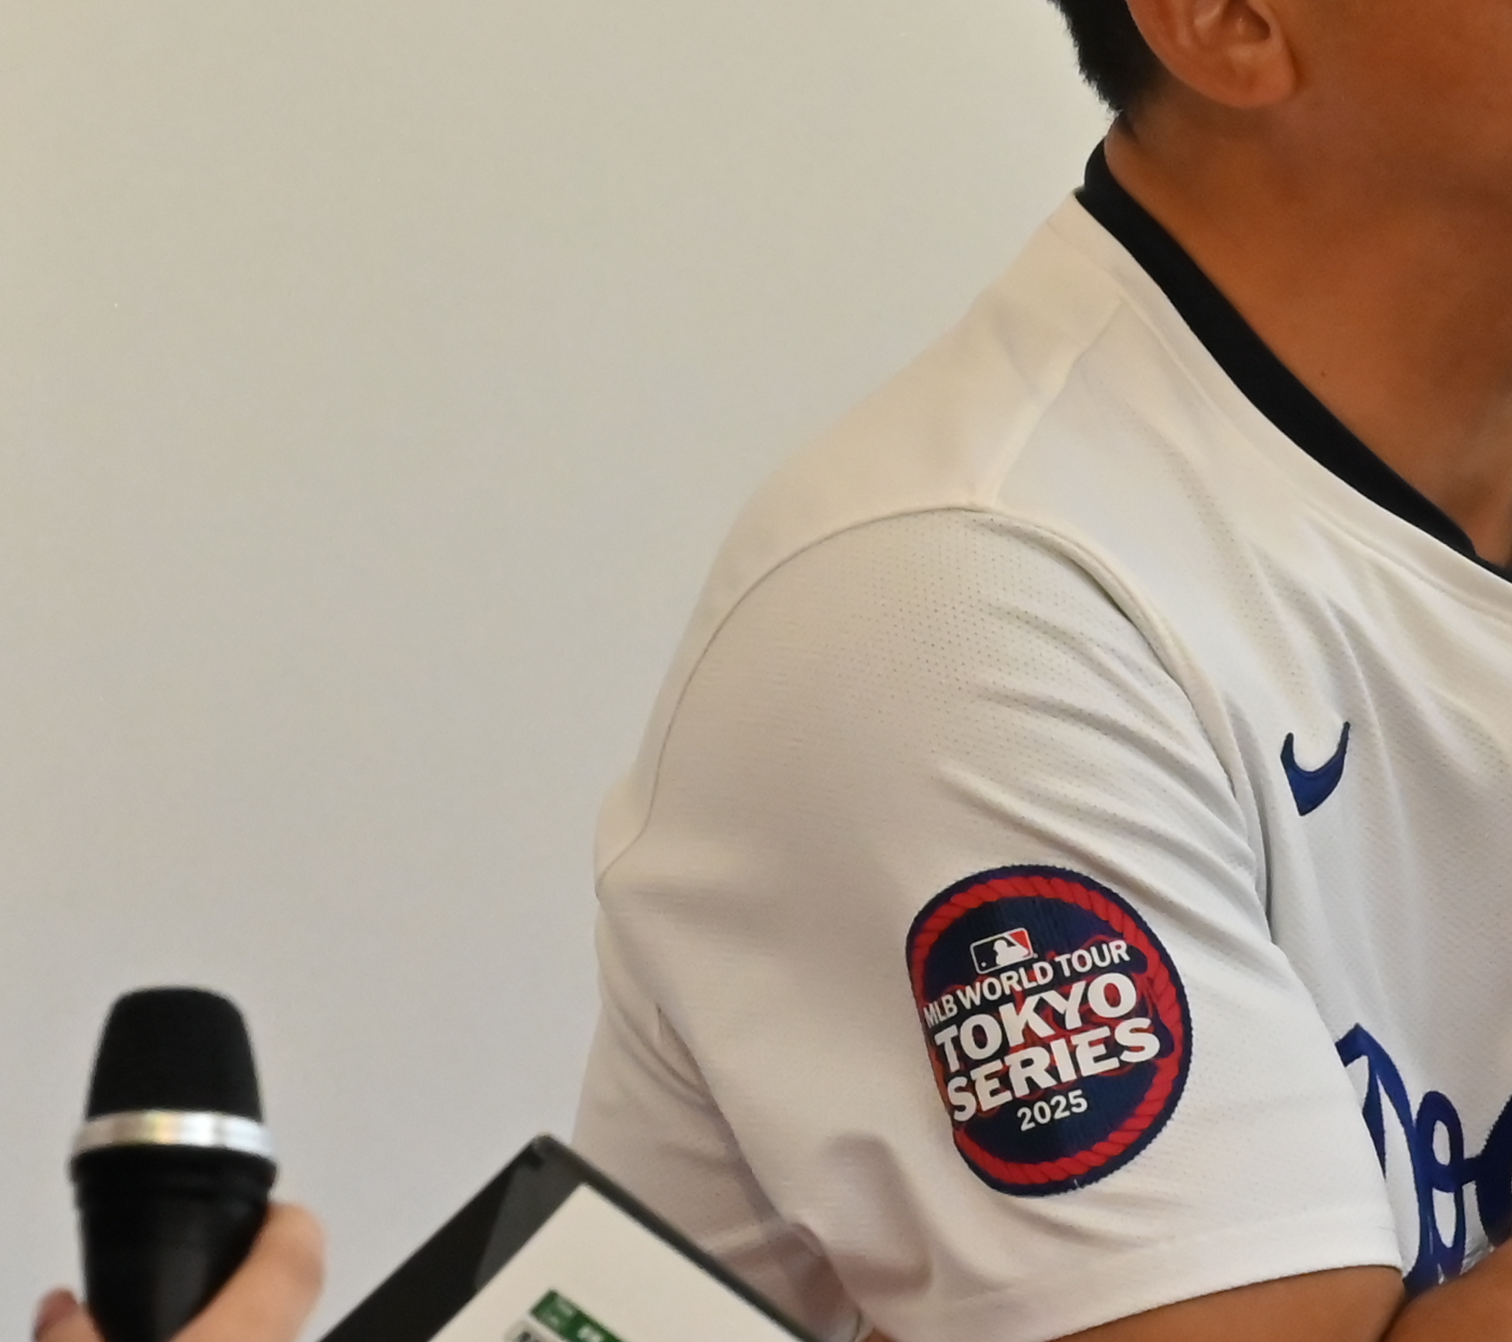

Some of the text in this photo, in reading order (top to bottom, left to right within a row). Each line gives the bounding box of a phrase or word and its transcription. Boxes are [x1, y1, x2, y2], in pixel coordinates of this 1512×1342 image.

[923, 938, 1131, 1029] MLB WORLD TOUR
[934, 972, 1137, 1073] TOKYO
[946, 1017, 1161, 1123] SERIES
[1016, 1089, 1089, 1132] 2025
